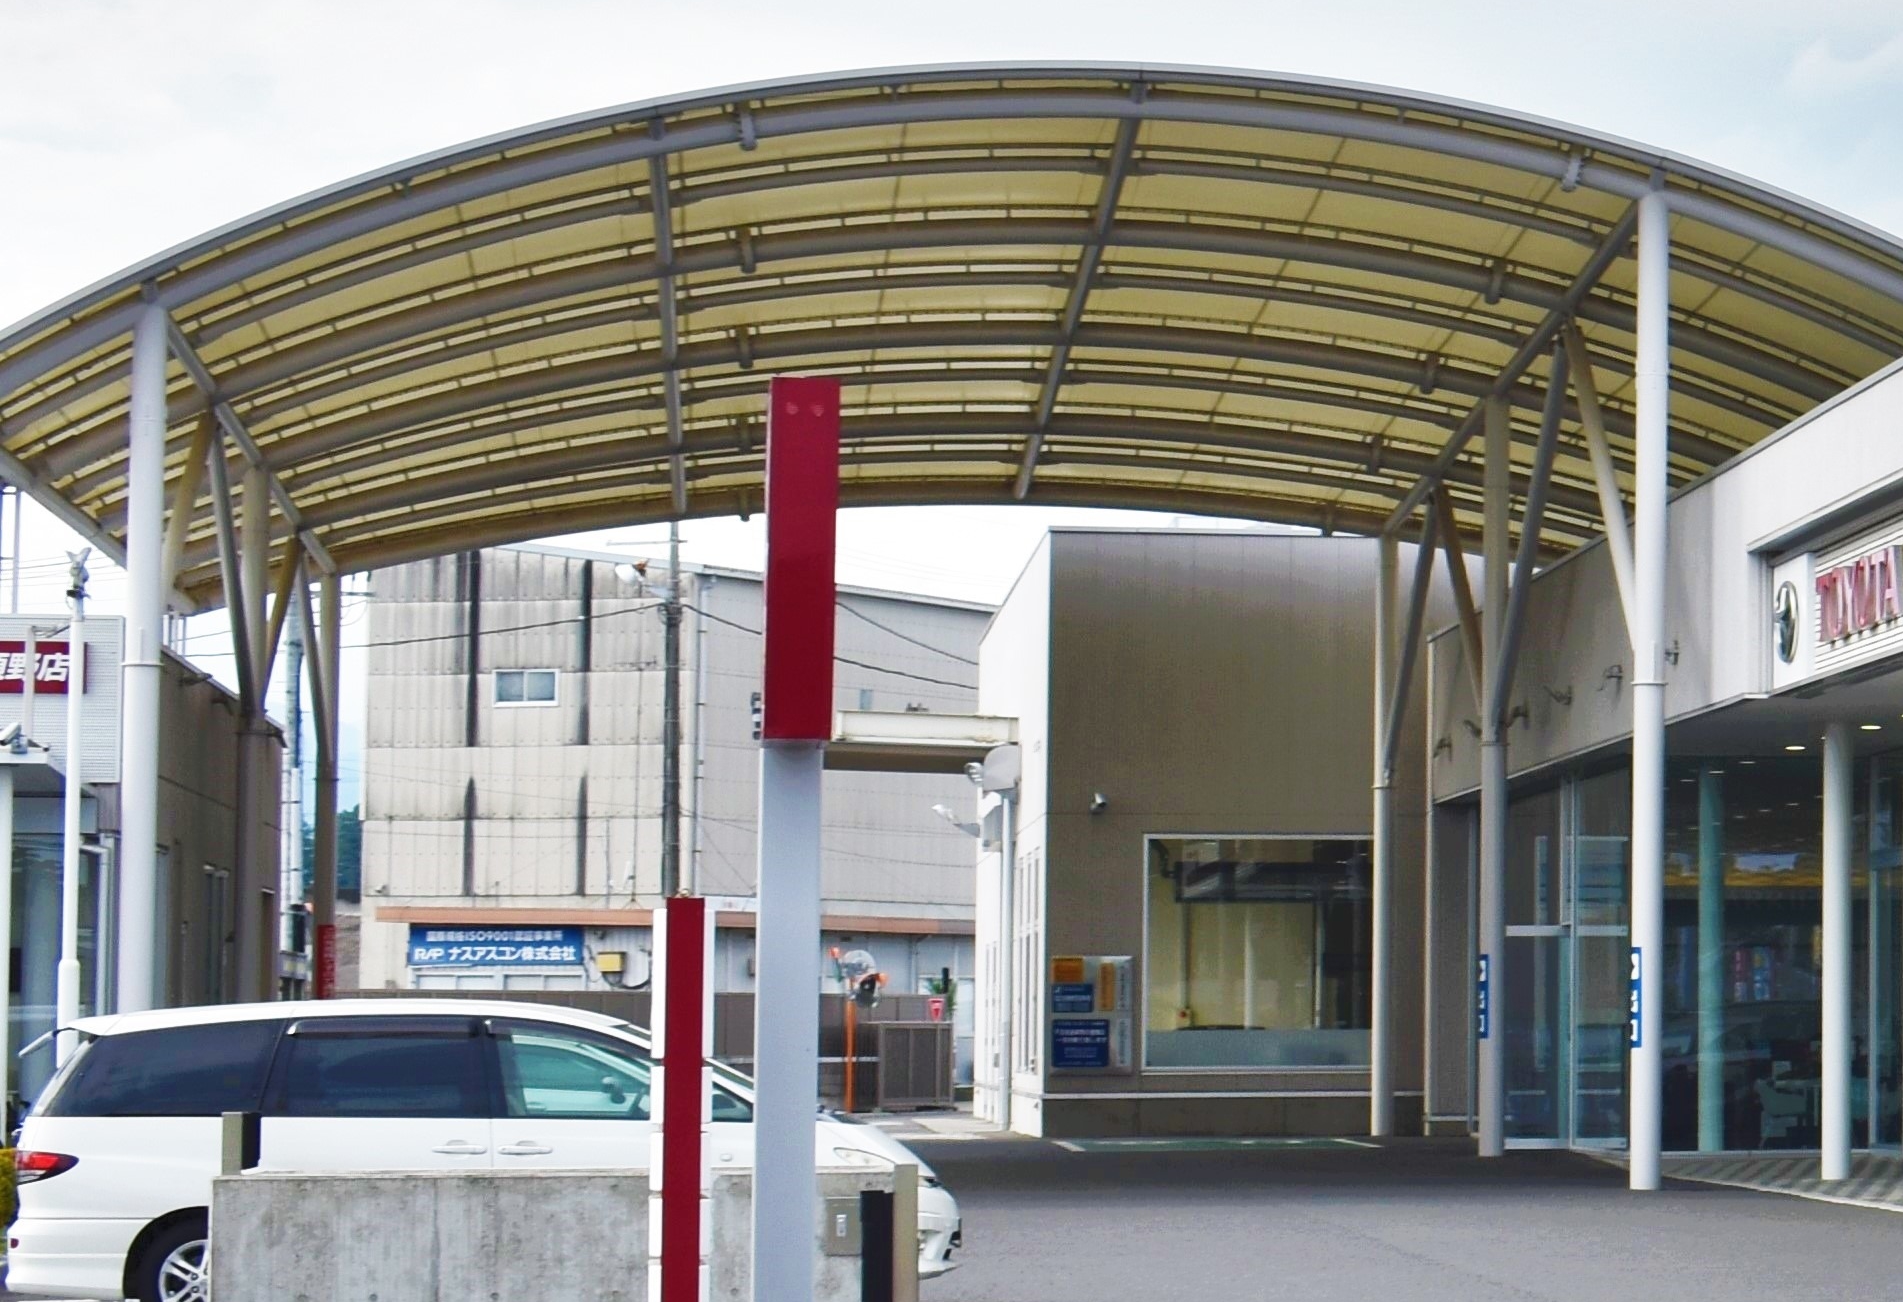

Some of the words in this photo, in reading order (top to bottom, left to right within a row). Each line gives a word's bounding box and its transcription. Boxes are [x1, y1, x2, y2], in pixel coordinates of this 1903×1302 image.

[0, 652, 70, 682] 野店
[449, 945, 577, 961] ナスアスコン株式会社
